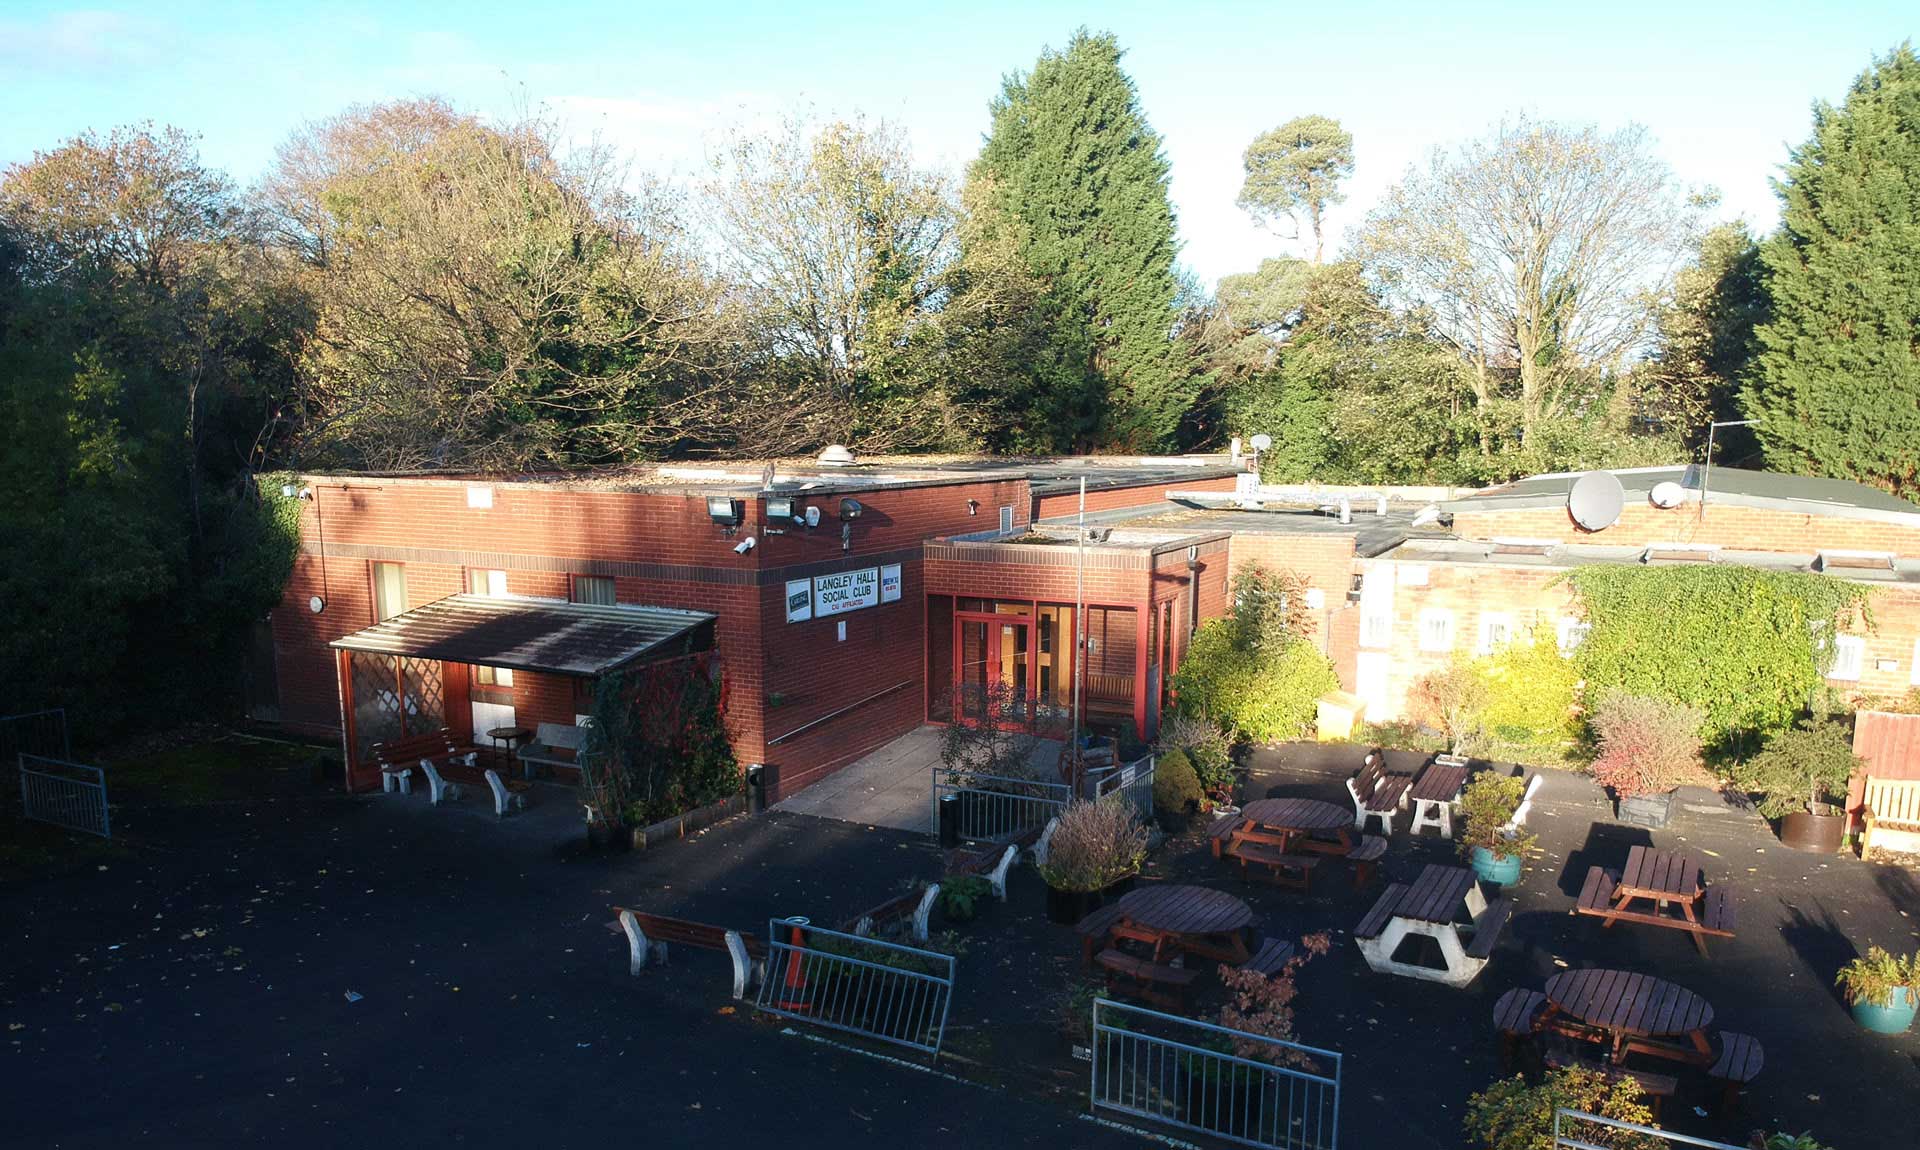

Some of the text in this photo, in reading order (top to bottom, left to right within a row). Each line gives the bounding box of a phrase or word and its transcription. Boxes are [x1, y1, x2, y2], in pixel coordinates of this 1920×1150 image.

[817, 572, 876, 592] LANGLEY HALL
[822, 589, 849, 603] SOCIAL
[853, 585, 871, 598] CLUB
